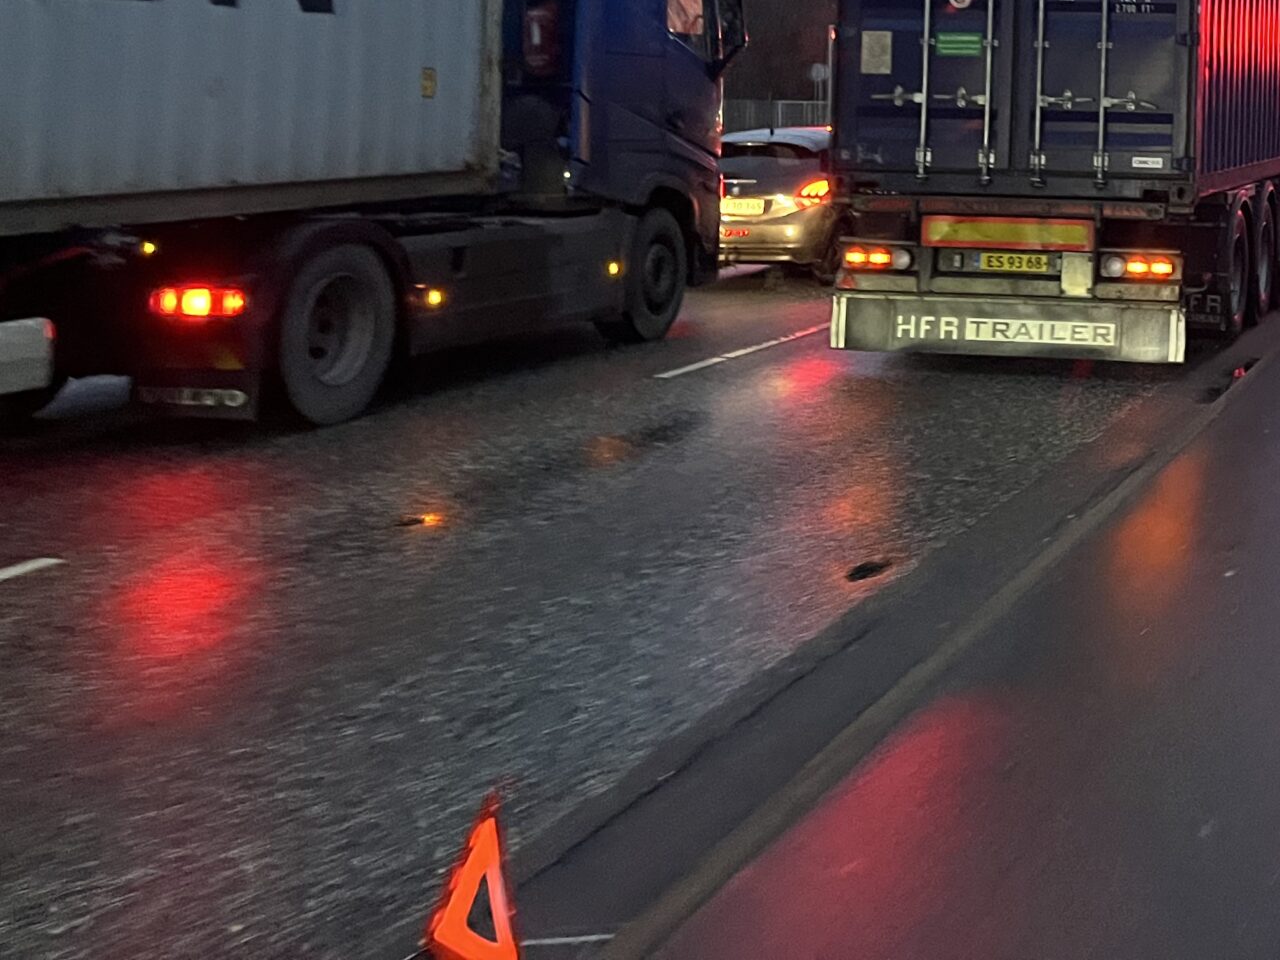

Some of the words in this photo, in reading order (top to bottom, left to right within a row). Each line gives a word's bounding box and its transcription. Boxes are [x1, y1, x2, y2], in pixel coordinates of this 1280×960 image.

[987, 255, 1004, 268] ES
[1008, 256, 1023, 269] 93
[1190, 294, 1222, 314] FR
[896, 315, 960, 340] HFR
[969, 320, 1112, 343] TRAILER
